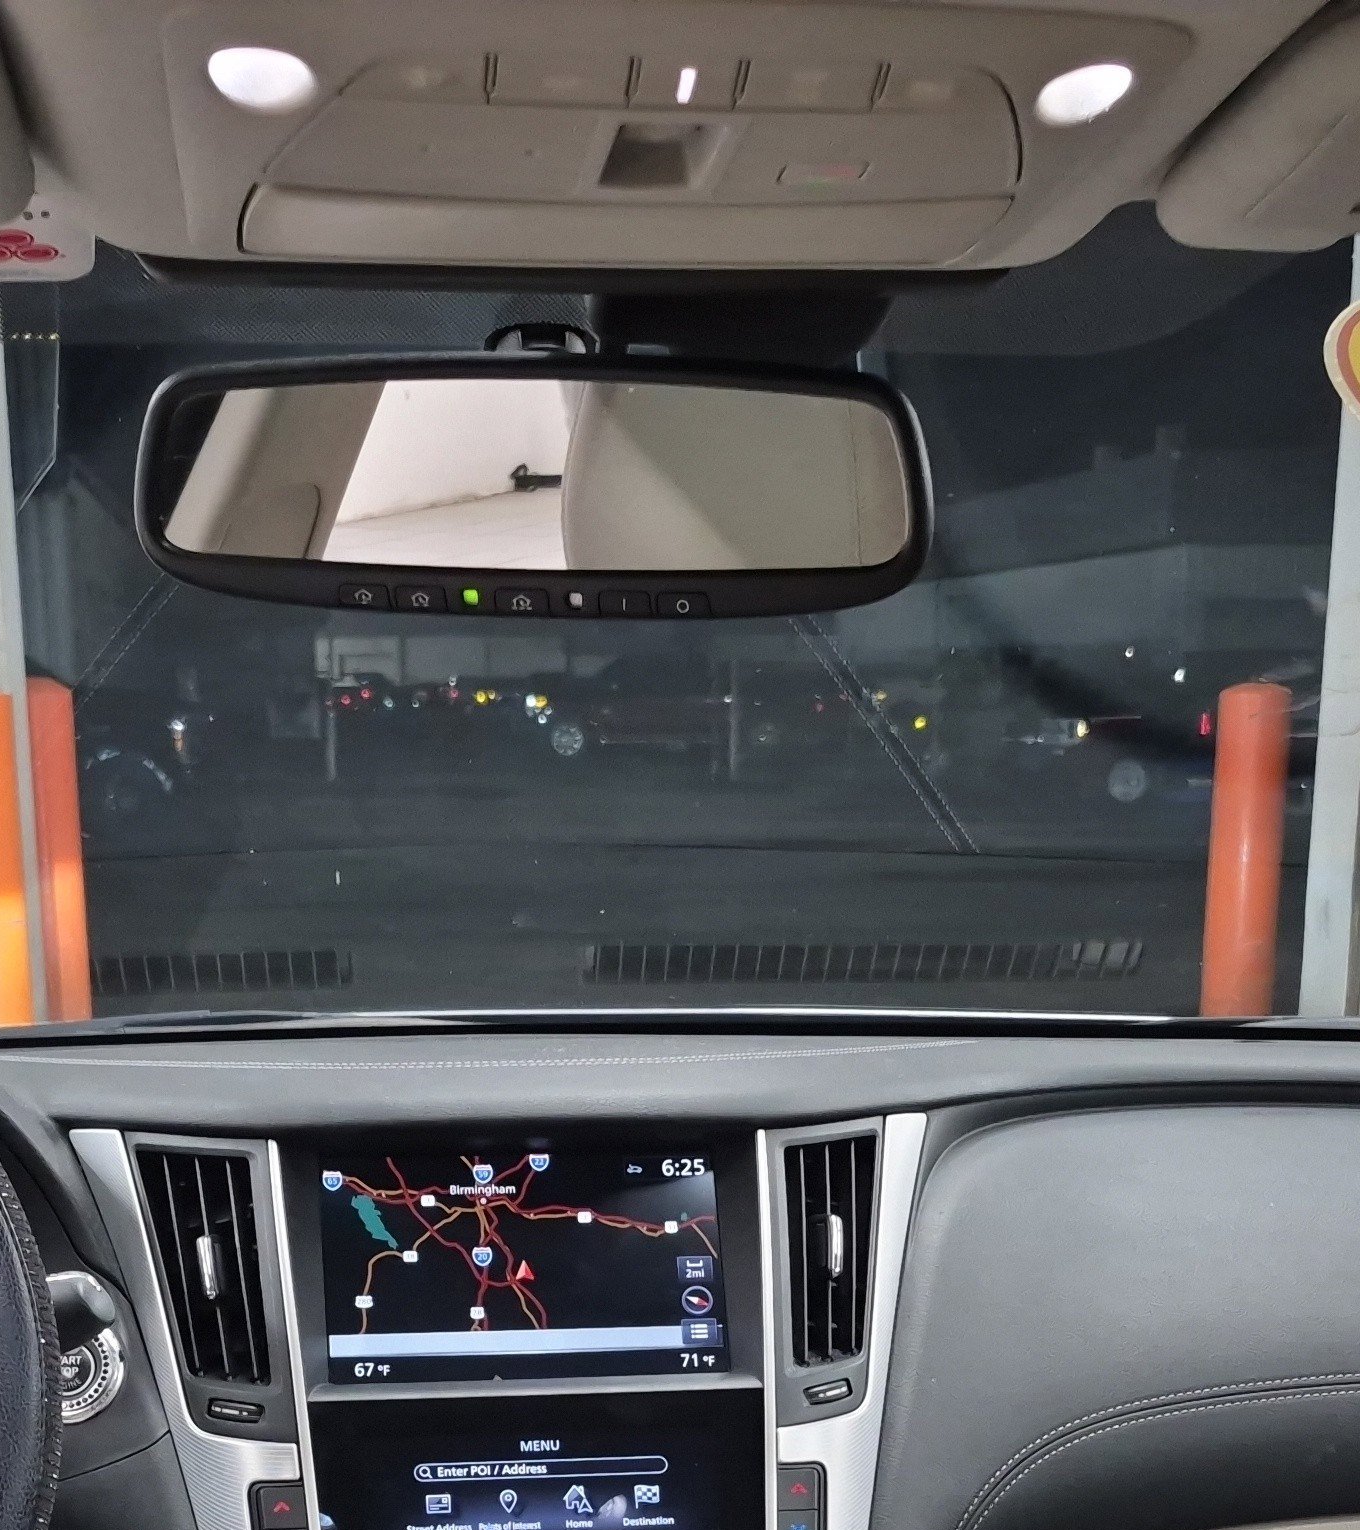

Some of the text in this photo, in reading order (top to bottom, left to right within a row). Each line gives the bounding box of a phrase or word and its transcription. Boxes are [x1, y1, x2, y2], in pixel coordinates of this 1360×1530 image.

[661, 1158, 706, 1177] 6:25
[327, 1177, 338, 1185] 65
[449, 1184, 516, 1196] Birmingham
[477, 1253, 488, 1261] 20
[681, 1353, 698, 1368] 71
[354, 1362, 375, 1378] 67
[520, 1439, 560, 1452] MENU
[437, 1463, 547, 1478] Enter POI / Address
[501, 1521, 511, 1530] of
[512, 1520, 541, 1530] Interest
[565, 1519, 593, 1529] Home
[623, 1515, 675, 1527] Destination
